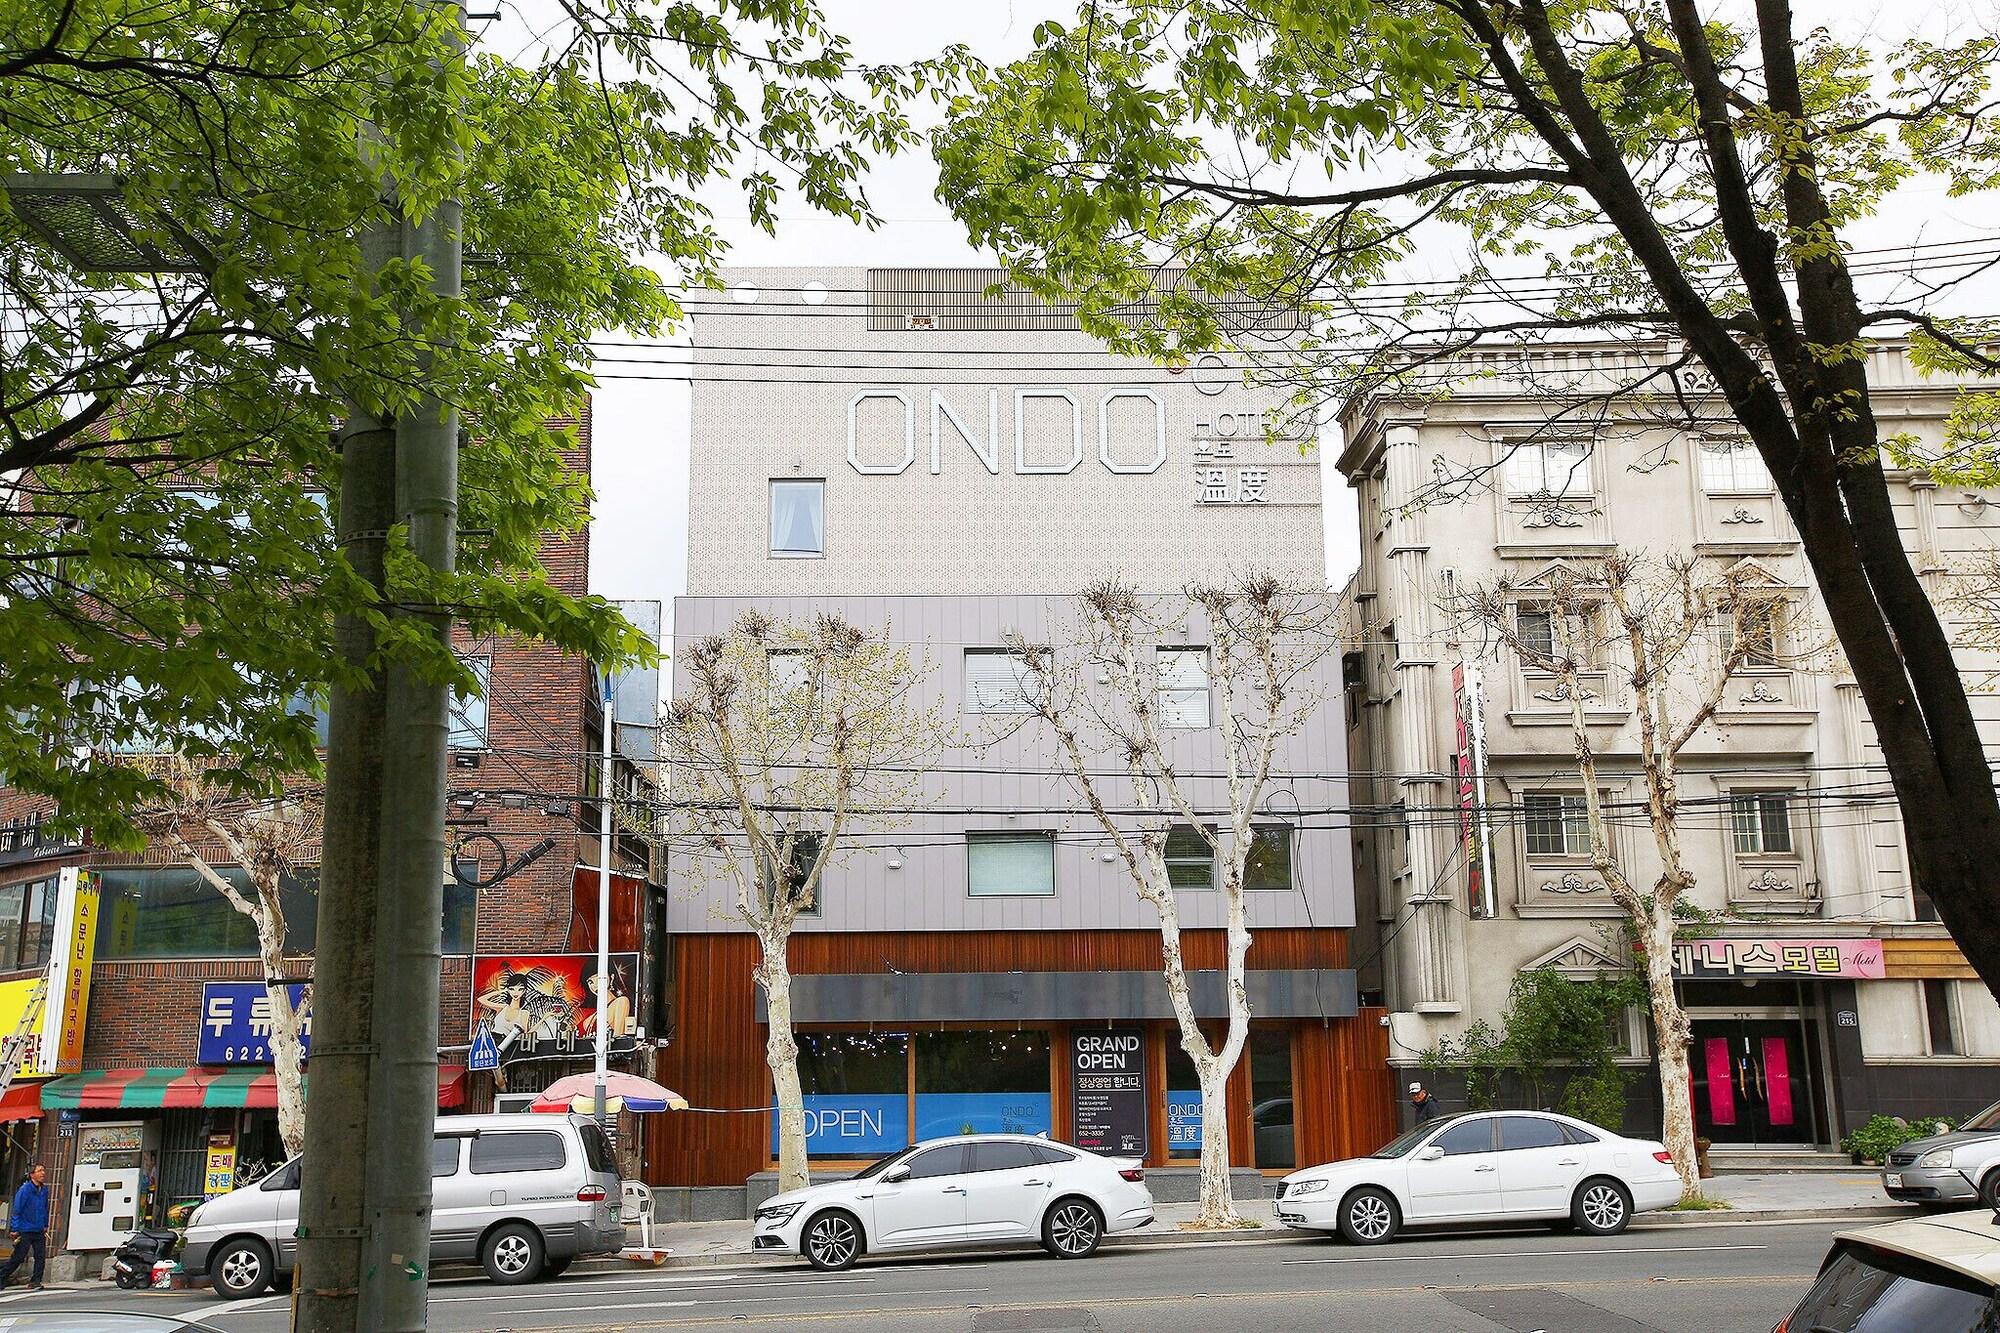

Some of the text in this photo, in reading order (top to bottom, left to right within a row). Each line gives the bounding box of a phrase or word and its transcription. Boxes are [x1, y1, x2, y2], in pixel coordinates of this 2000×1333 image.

[847, 387, 1167, 476] ONDO
[1195, 465, 1270, 504] 溫度
[77, 903, 89, 961] 소문난
[1842, 950, 1877, 965] Motel
[1076, 1036, 1139, 1052] GRAND
[1077, 1053, 1126, 1069] OPEN
[1078, 1076, 1141, 1089] 정상영업 합니다.
[1002, 1105, 1033, 1117] ONDO
[60, 1129, 73, 1137] 213
[209, 1154, 233, 1169] 도배
